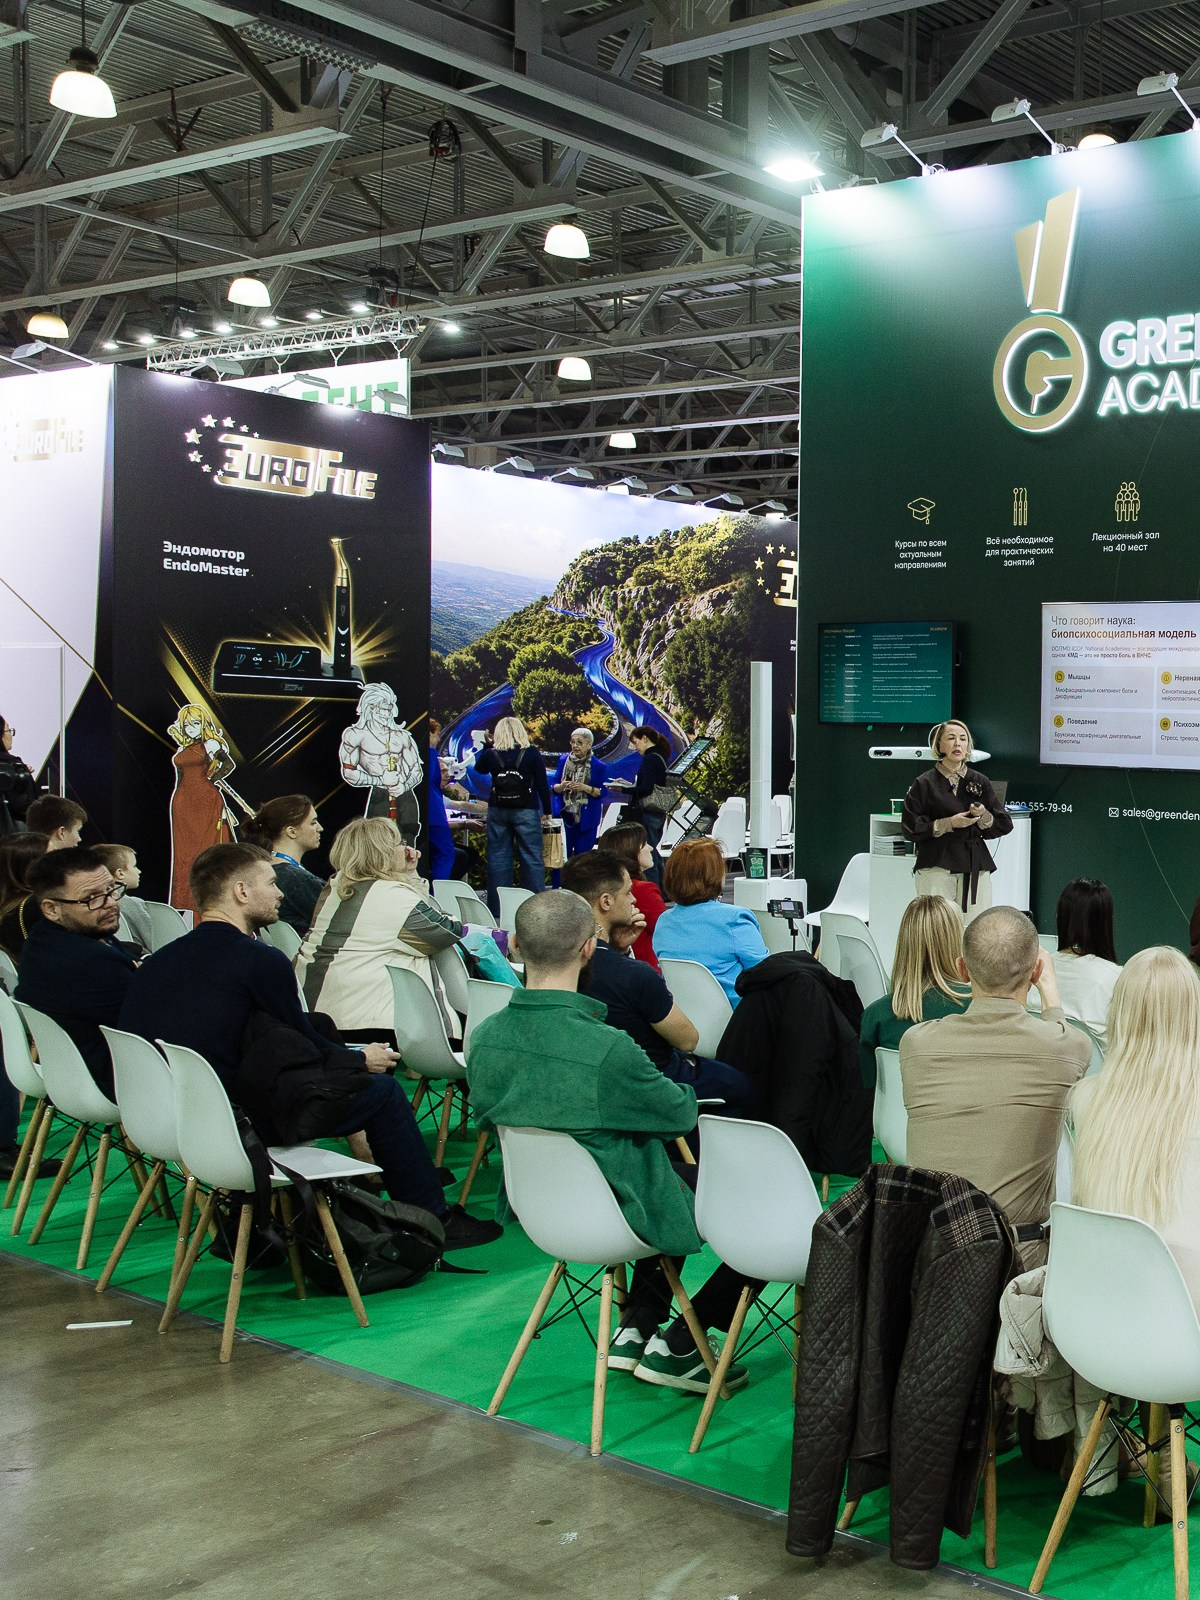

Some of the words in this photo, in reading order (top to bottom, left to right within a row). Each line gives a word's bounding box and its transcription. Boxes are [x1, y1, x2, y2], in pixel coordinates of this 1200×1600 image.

[986, 536, 1000, 545] Всё
[1002, 535, 1054, 545] необходимое
[1092, 532, 1143, 542] Лекционный
[1144, 532, 1160, 540] зал
[894, 540, 916, 549] Курсы
[1115, 543, 1126, 552] 40
[1128, 544, 1148, 552] мест
[162, 541, 245, 562] Эндомотор
[985, 549, 1000, 557] для
[1000, 547, 1054, 557] практических
[894, 561, 947, 570] направлениям
[1003, 557, 1035, 566] занятий
[163, 558, 250, 577] EndoMaster
[1052, 616, 1068, 626] Что
[1070, 617, 1104, 627] говорит
[1106, 617, 1136, 628] наука:
[1052, 628, 1156, 640] биопсихосоциальная
[1158, 630, 1197, 640] модель
